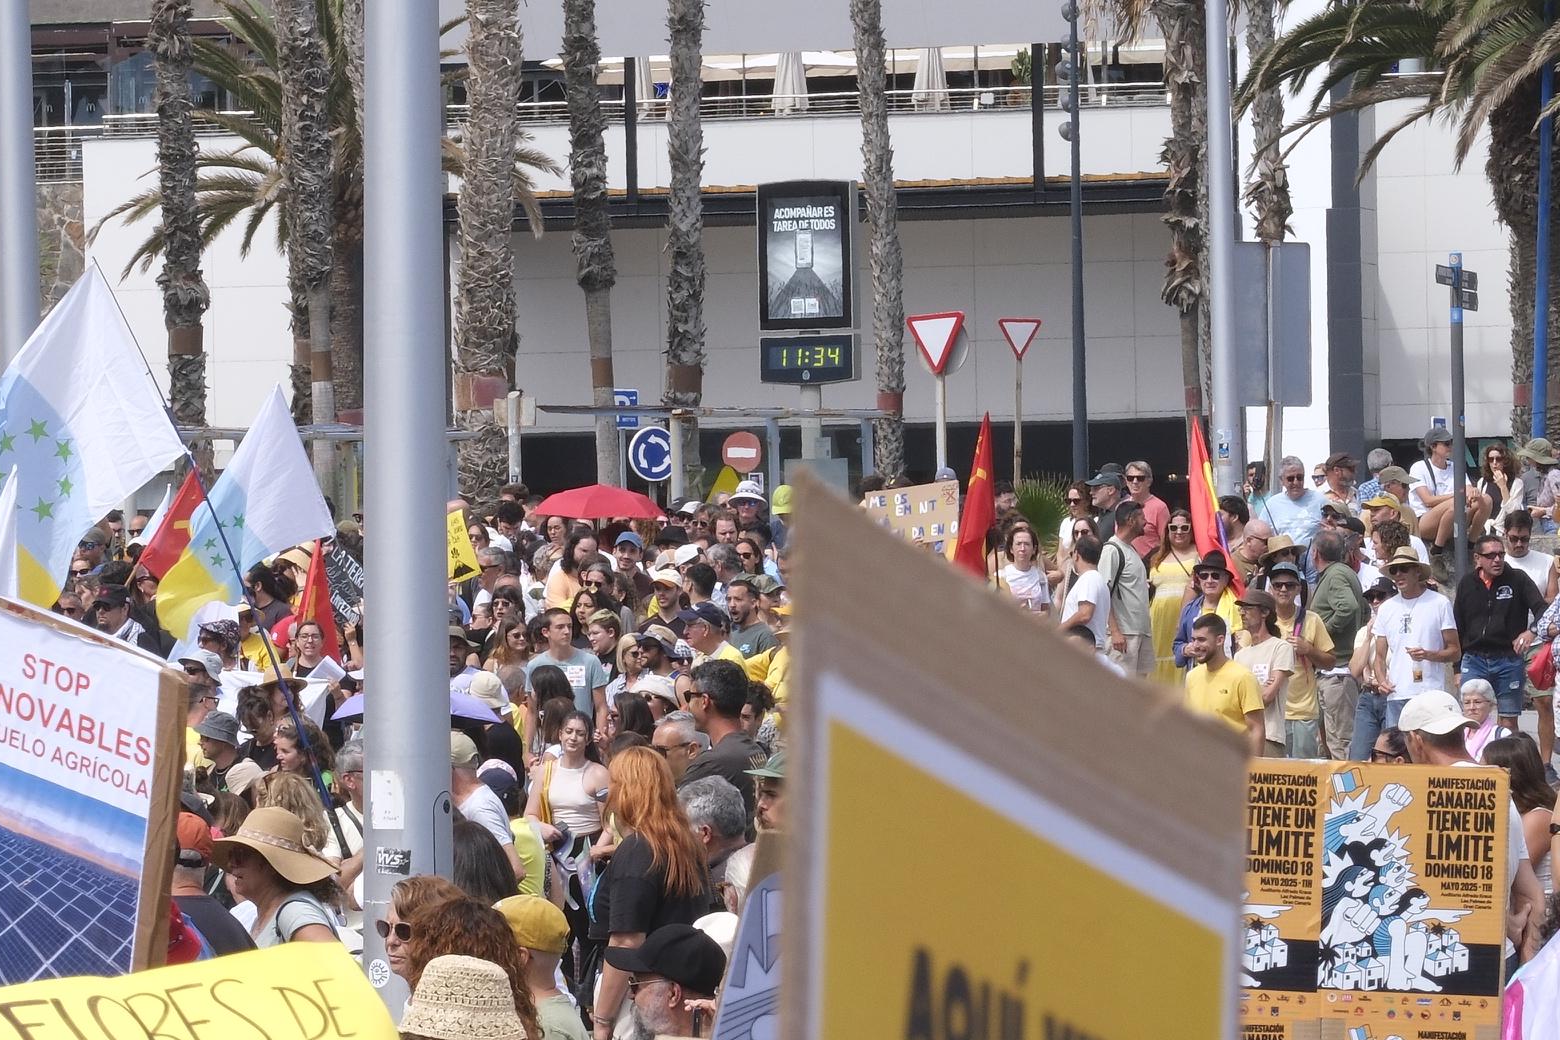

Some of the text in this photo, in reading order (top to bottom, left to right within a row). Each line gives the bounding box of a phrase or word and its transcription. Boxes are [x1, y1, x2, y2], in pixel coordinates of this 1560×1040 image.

[774, 205, 835, 219] ACOMPAÑAR ES
[773, 219, 835, 232] TAREA DE TODOS
[781, 347, 839, 367] 11:34
[21, 653, 91, 697] STOP
[50, 745, 149, 799] AGRÍCOLA
[1248, 773, 1317, 787] MANIFESTACIÓN
[1428, 777, 1497, 791] MANIFESTACIÓN
[1248, 786, 1317, 807] CANARIAS
[1427, 790, 1496, 811] CANARIAS
[1248, 805, 1316, 829] TIENE UN
[1427, 809, 1496, 833] TIENE UN
[1247, 826, 1315, 858] LÍMITE
[1425, 830, 1495, 862] LÍMITE
[1300, 861, 1313, 876] 18
[1425, 862, 1494, 880] DOMINGO 18
[1260, 877, 1279, 886] MAYO
[1280, 878, 1298, 888] 2025
[1441, 881, 1459, 891] MAYO
[1460, 882, 1478, 892] 2025
[1418, 1031, 1467, 1040] MANIFESTACIÓN
